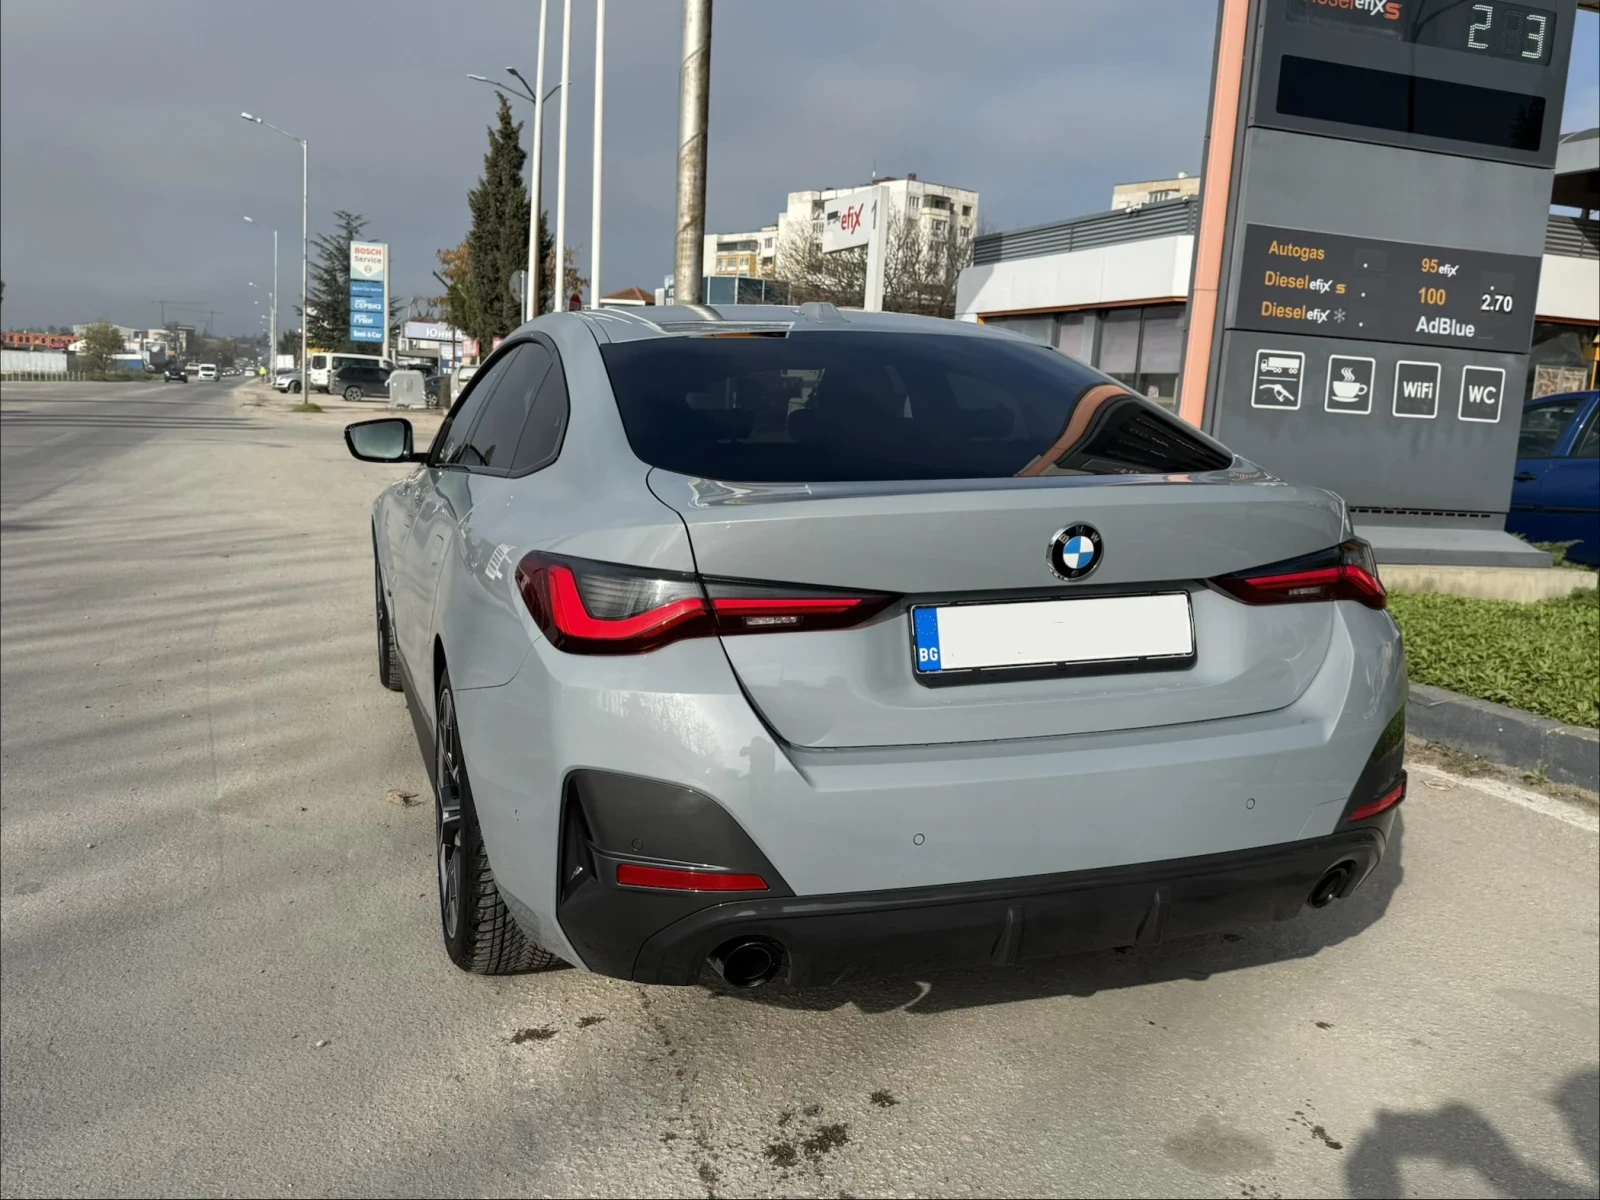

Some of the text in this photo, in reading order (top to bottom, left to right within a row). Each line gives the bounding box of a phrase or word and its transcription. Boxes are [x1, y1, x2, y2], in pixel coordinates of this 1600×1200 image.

[1468, 4, 1546, 58] 2 3
[841, 203, 864, 235] efix
[354, 247, 382, 256] BOSCH
[354, 255, 382, 264] Service
[1268, 240, 1325, 261] Autogas
[1418, 287, 1447, 305] 100
[1481, 294, 1513, 312] 2.70
[1415, 316, 1475, 337] AdBlue
[1403, 381, 1434, 399] WiFi
[1468, 385, 1497, 404] WC
[1058, 525, 1100, 544] BMW
[919, 647, 939, 662] BG
